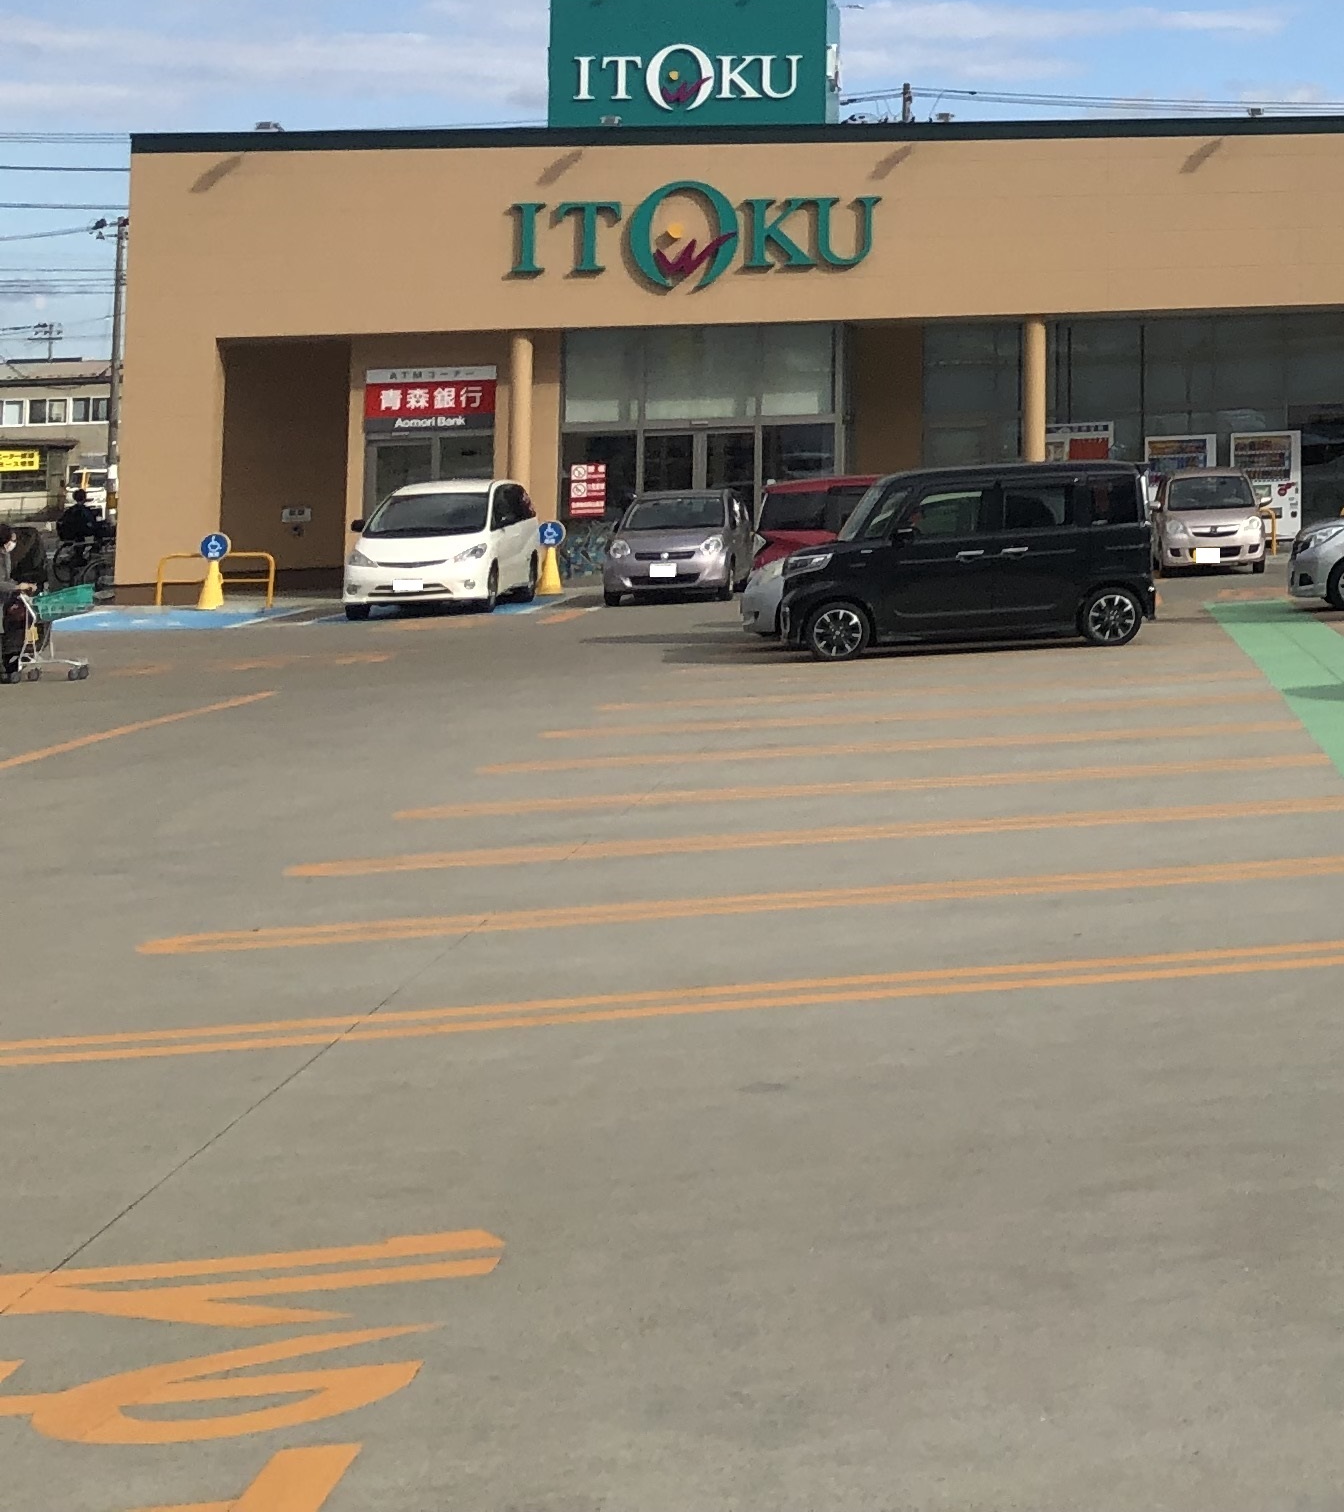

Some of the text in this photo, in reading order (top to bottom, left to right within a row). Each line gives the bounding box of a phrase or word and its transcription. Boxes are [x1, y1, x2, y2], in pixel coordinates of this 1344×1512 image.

[573, 43, 803, 111] ITOKU
[511, 180, 882, 294] ITOKU
[379, 386, 483, 411] 青森銀行
[394, 415, 466, 428] Aomori Bank
